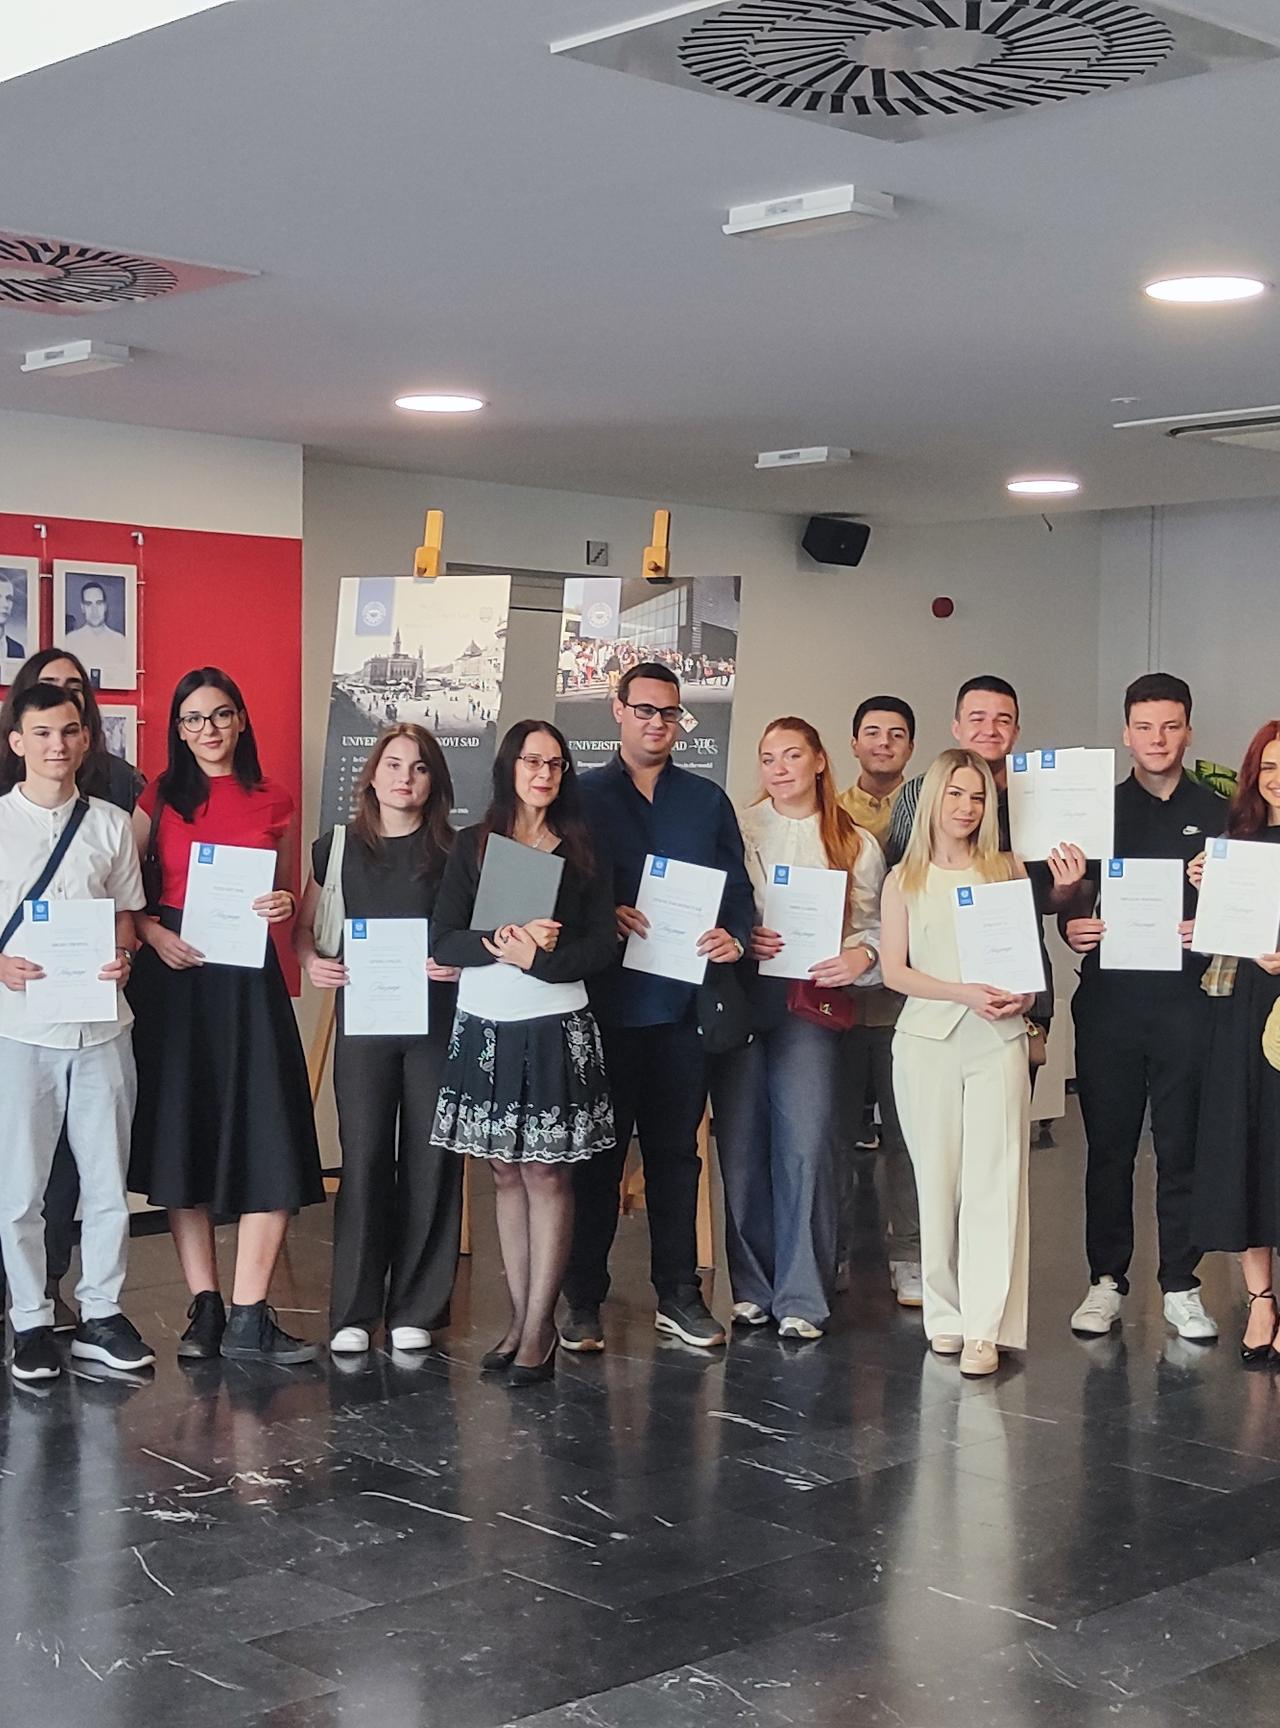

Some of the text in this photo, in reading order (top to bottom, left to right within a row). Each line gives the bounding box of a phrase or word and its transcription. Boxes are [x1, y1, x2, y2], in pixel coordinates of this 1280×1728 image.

[342, 736, 480, 747] UNIVER NOVI SAD
[672, 740, 687, 751] AD
